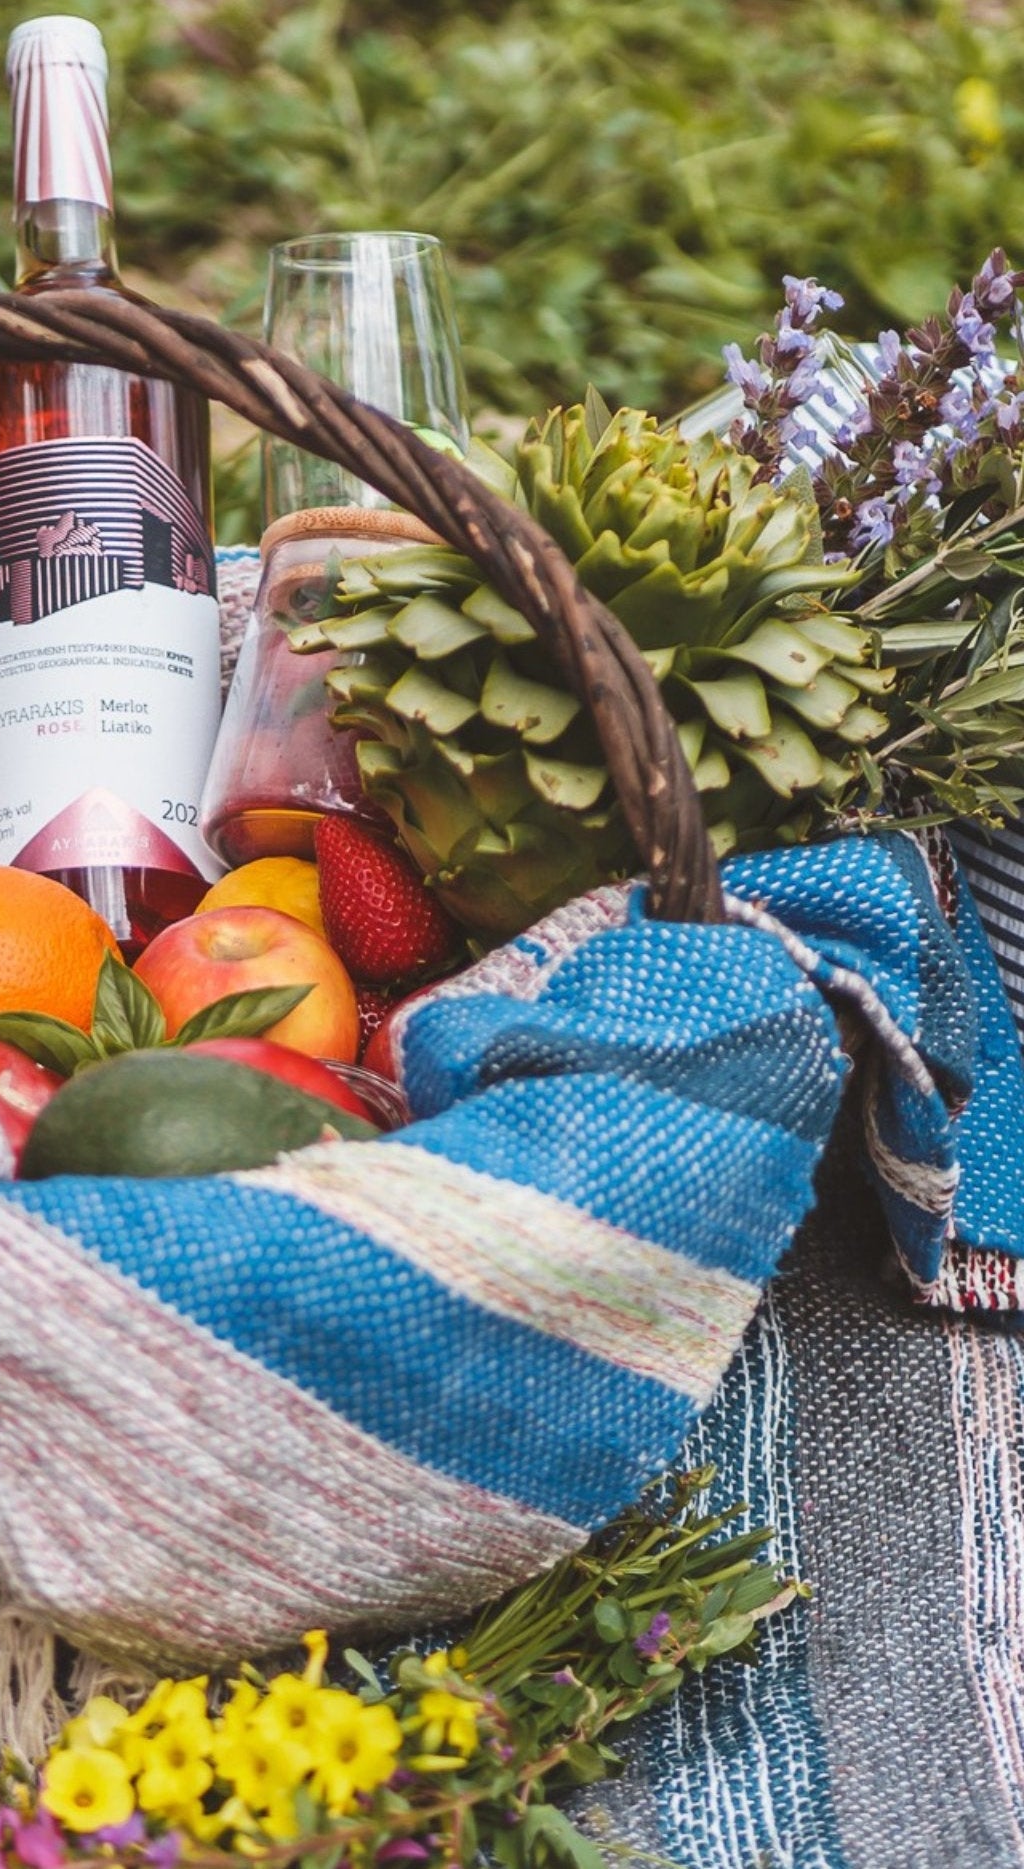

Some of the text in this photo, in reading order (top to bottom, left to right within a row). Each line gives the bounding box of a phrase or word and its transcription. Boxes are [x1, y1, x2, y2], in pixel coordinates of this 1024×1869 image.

[37, 655, 111, 671] GEOGRAPHICAL
[112, 656, 166, 671] INDICATION
[100, 698, 149, 714] Merlot
[101, 719, 152, 735] Liatiko
[15, 799, 32, 815] vol
[160, 799, 198, 828] 202
